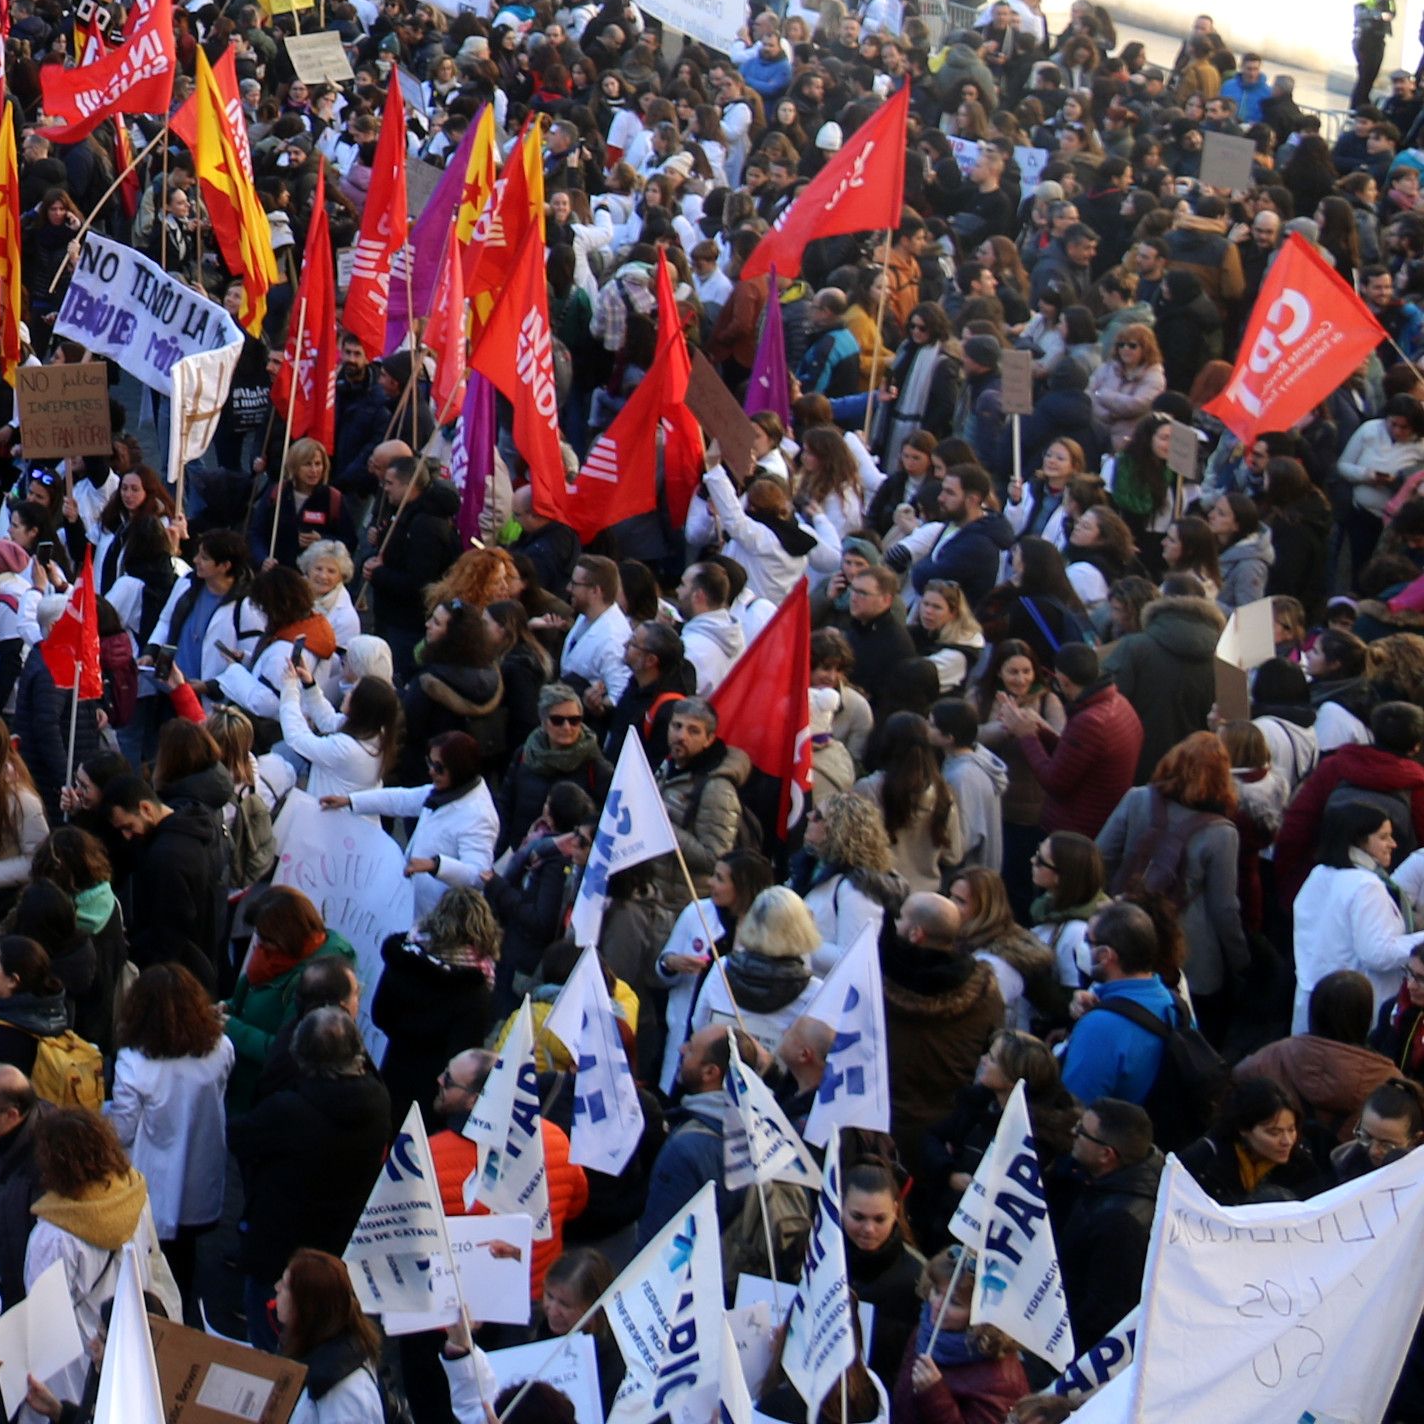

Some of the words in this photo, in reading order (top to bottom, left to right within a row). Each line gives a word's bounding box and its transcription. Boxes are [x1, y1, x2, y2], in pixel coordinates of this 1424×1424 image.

[79, 238, 120, 283] NO
[183, 302, 211, 344] LA
[20, 371, 49, 393] NO
[517, 1164, 545, 1204] FEDERA
[375, 1230, 391, 1241] DE
